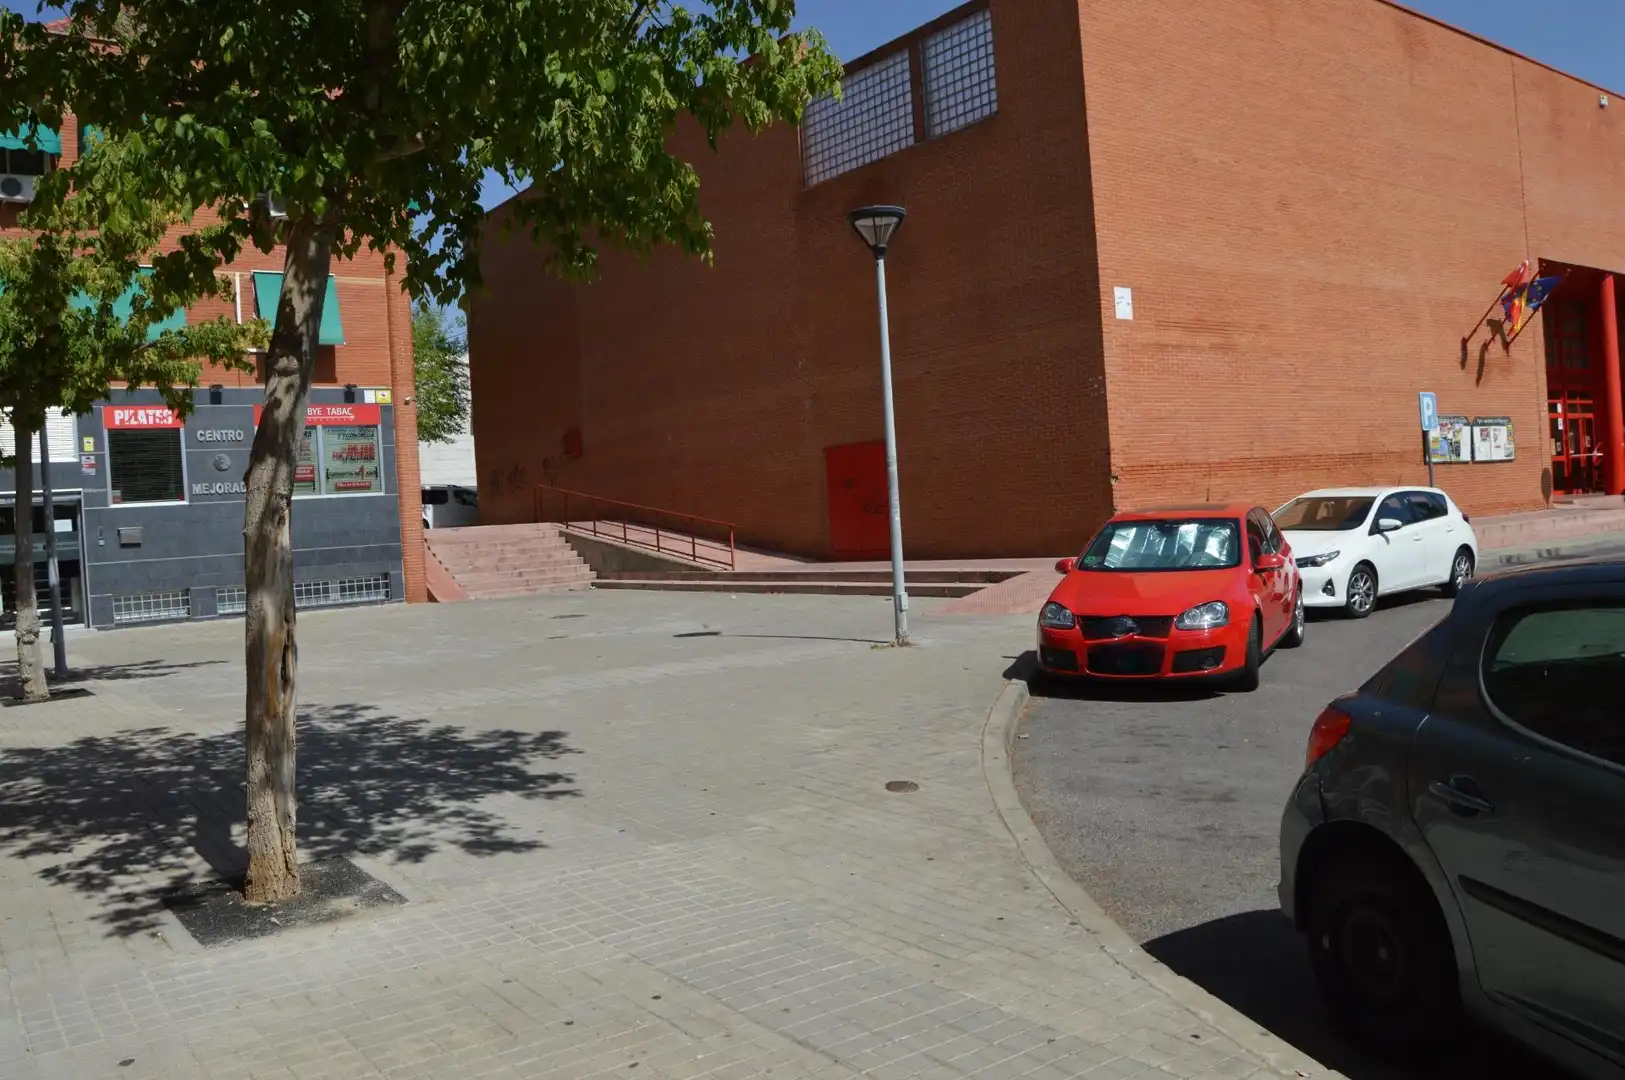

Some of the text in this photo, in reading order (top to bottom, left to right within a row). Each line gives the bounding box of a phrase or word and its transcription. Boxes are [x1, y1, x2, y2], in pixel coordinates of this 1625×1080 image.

[114, 409, 173, 425] PILATES
[307, 407, 353, 416] BYE TABAC
[196, 430, 244, 442] CENTRO
